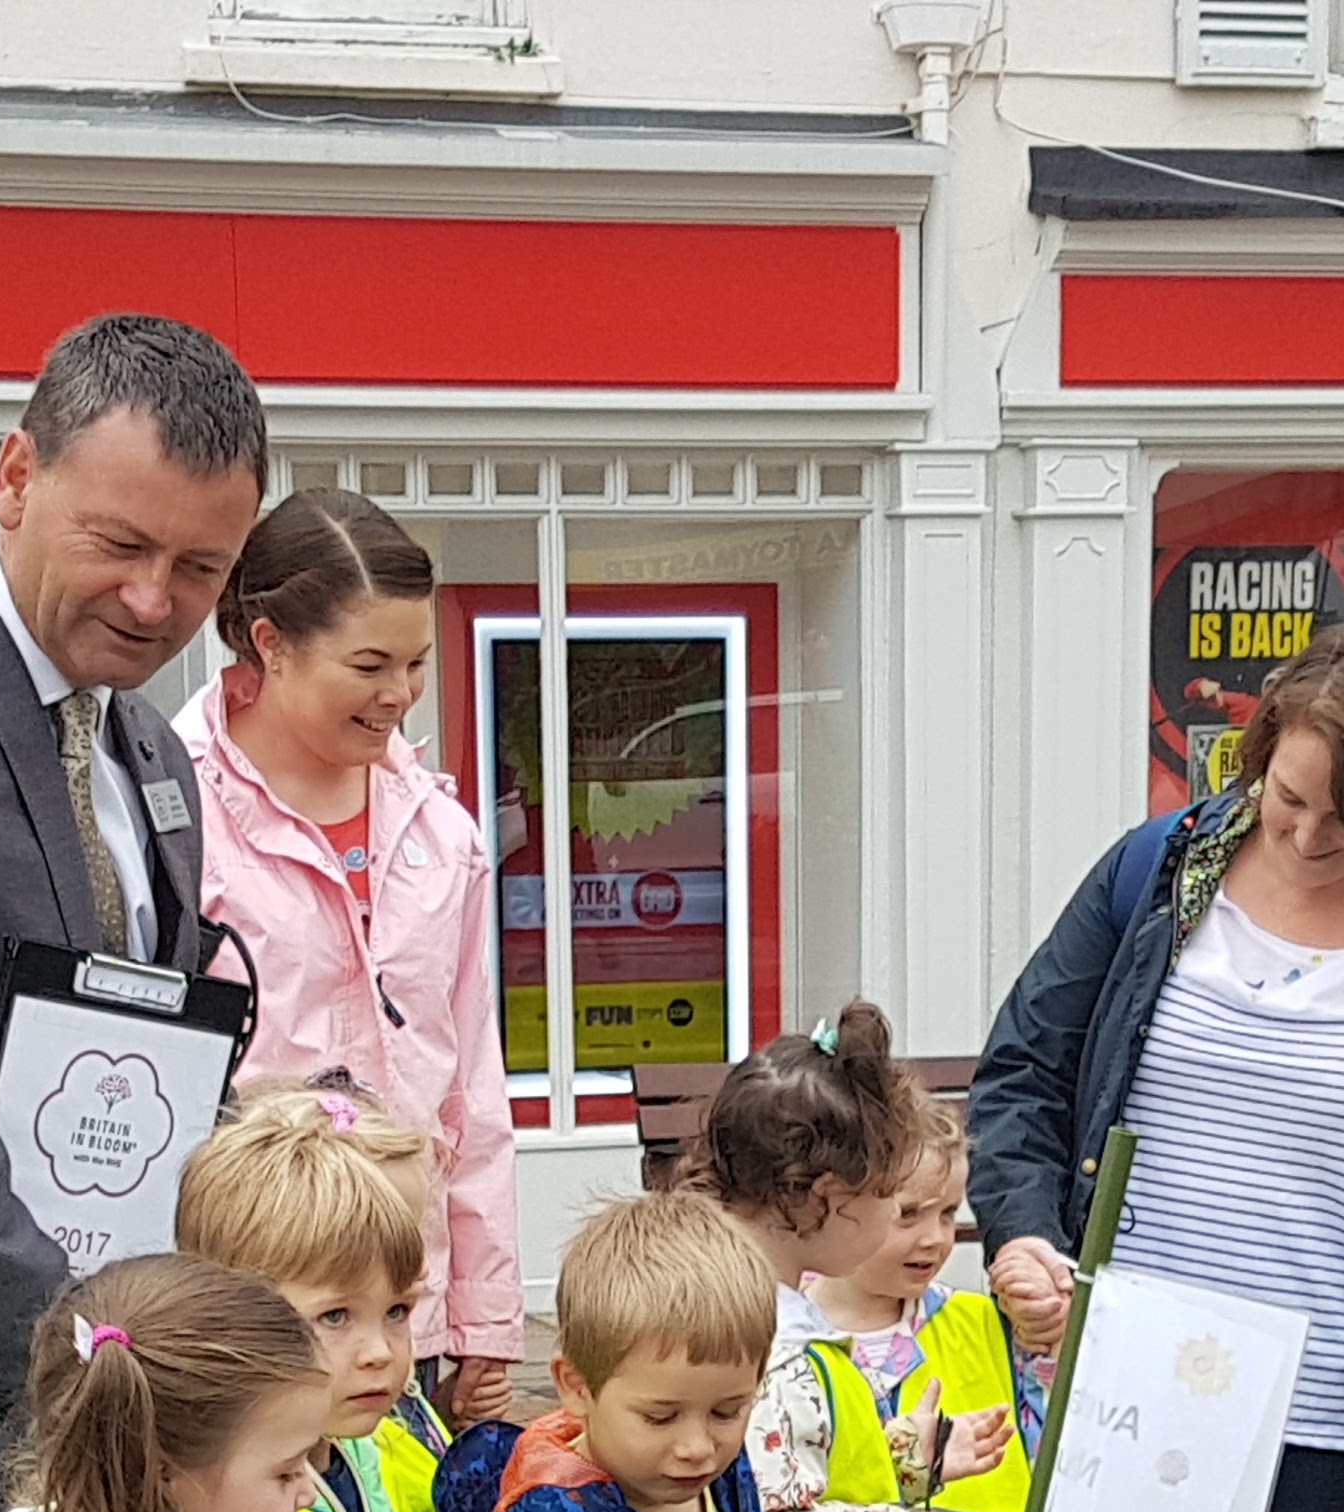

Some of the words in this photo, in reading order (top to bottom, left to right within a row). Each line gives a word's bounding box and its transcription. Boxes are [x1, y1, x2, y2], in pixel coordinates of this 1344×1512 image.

[1190, 560, 1316, 610] RACING
[1189, 612, 1222, 658] IS
[1230, 612, 1314, 658] BACK
[573, 880, 621, 906] XTRA
[585, 1005, 633, 1027] FUN
[70, 1132, 85, 1146] IN
[79, 1116, 131, 1137] BRITAIN
[53, 1225, 112, 1257] 2017
